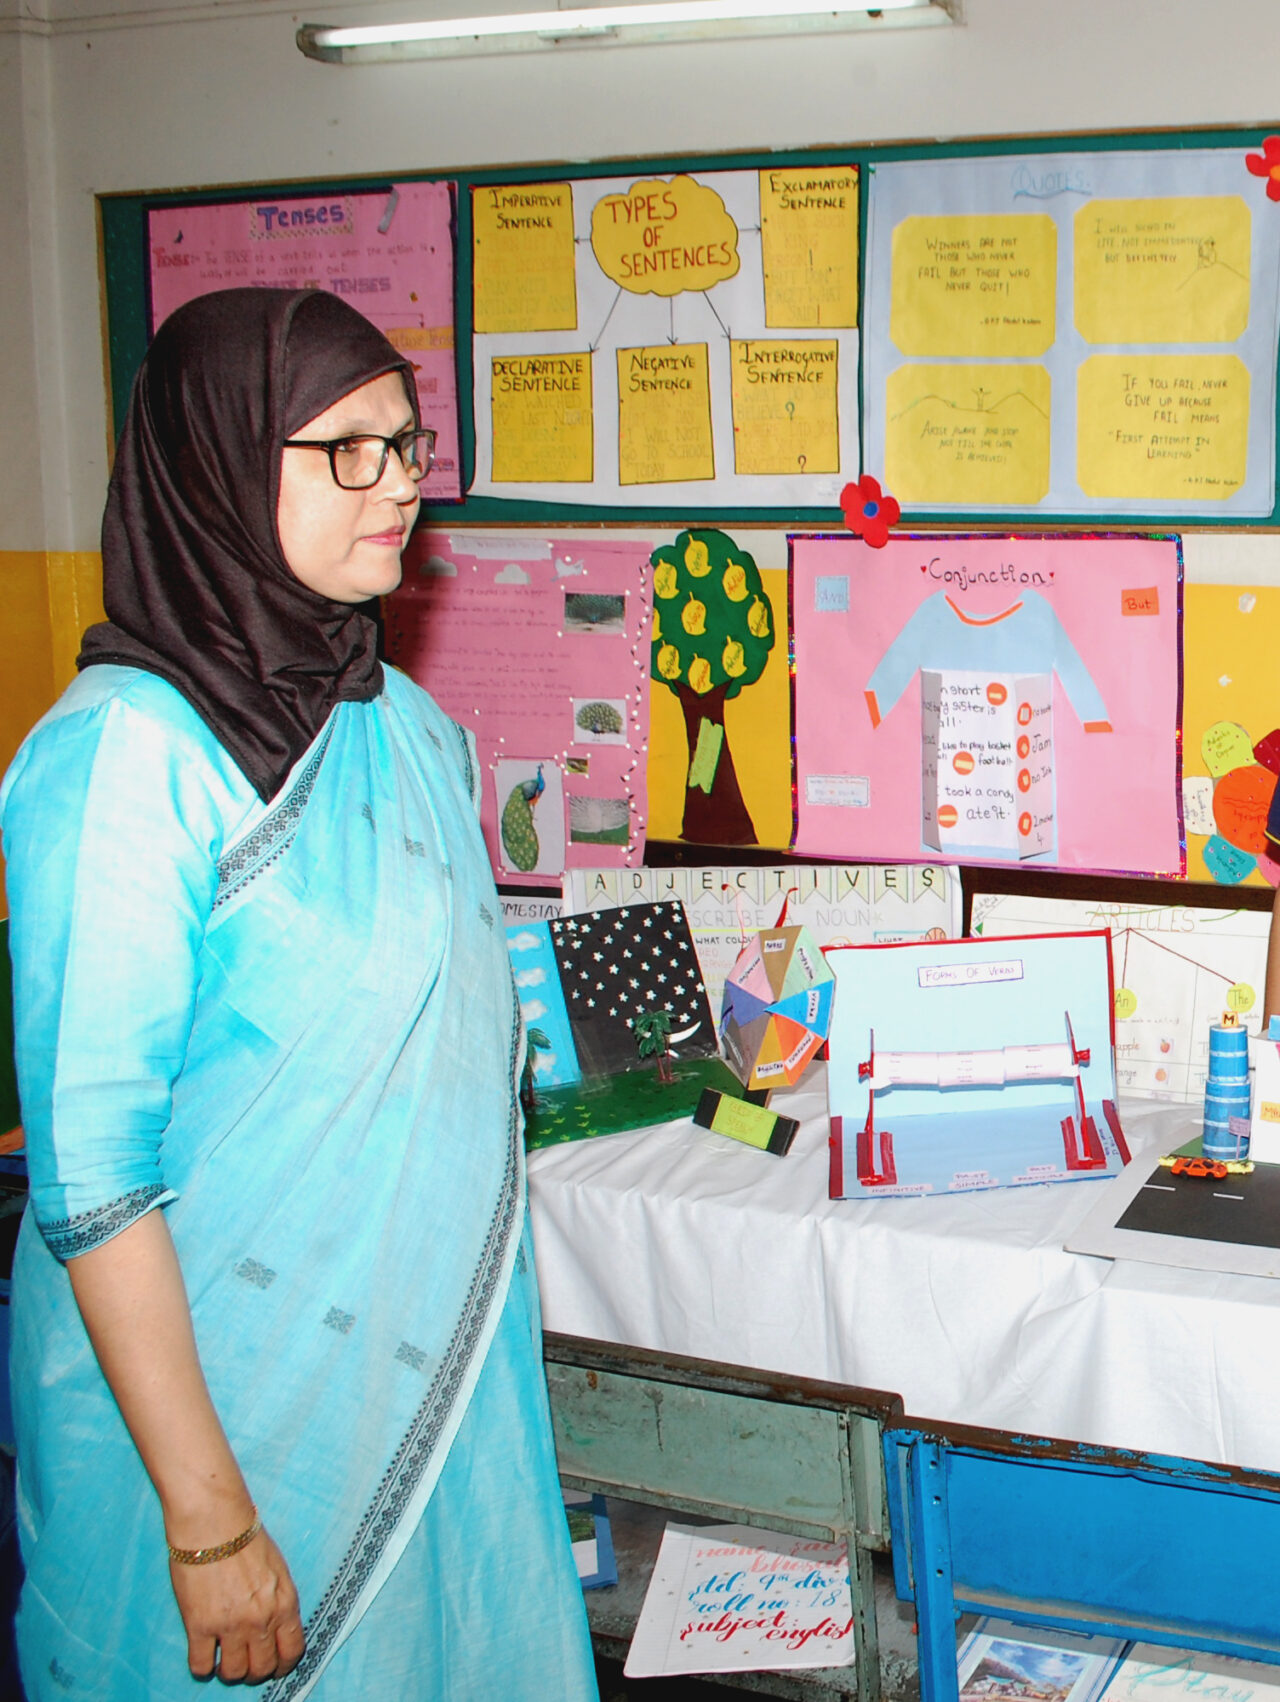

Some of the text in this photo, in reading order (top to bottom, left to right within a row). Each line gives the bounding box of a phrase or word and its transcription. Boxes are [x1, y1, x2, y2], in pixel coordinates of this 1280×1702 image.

[769, 172, 859, 193] EXCLAMATORY
[489, 189, 563, 209] IMPERATIVE
[604, 191, 679, 223] TYPES
[778, 194, 847, 210] SENTENCE
[257, 203, 344, 231] Tenses
[496, 212, 553, 230] SENTENCE
[642, 226, 664, 248] OF
[925, 236, 970, 251] WINNERS
[980, 237, 994, 248] ARE
[619, 244, 733, 278] SENTENCES
[934, 251, 1015, 262] THOSE WHO NEVER
[918, 266, 1031, 279] FAIL BUT THOSE WHO
[331, 278, 391, 293] TENSES
[945, 281, 1009, 297] NEVER QUIT!
[630, 349, 696, 375] NEGATIVE
[738, 342, 836, 367] INTERROGATIVE
[492, 359, 583, 377] DECLARATIVE
[746, 365, 824, 384] SENTENCE
[499, 376, 581, 392] SENTENCE
[629, 372, 692, 392] SENTENCE
[1122, 373, 1228, 391] IF YOU NEVER
[1124, 393, 1212, 408] GIVE UP BECAUSE
[1154, 410, 1220, 424] FAIL MEANS
[645, 426, 700, 443] WILL NOT
[1151, 434, 1210, 446] ATTEMPT IN
[622, 443, 710, 460] GO TO SCHOOL
[929, 558, 1047, 590] Conjunction
[1127, 597, 1152, 611] But
[987, 704, 997, 716] is
[945, 784, 1015, 803] took a candy
[966, 806, 989, 820] ate
[593, 868, 936, 890] ADJECTIVES
[688, 909, 870, 929] SCRIBE NOUN
[1090, 904, 1196, 933] ARTICLES
[696, 936, 720, 945] WHAT
[966, 967, 980, 977] OF
[1115, 993, 1129, 1007] An
[1228, 988, 1249, 1006] The
[1223, 1014, 1235, 1026] M
[1116, 1040, 1140, 1058] apple
[695, 1545, 766, 1558] name
[692, 1589, 842, 1613] roll 18
[680, 1611, 790, 1643] subject
